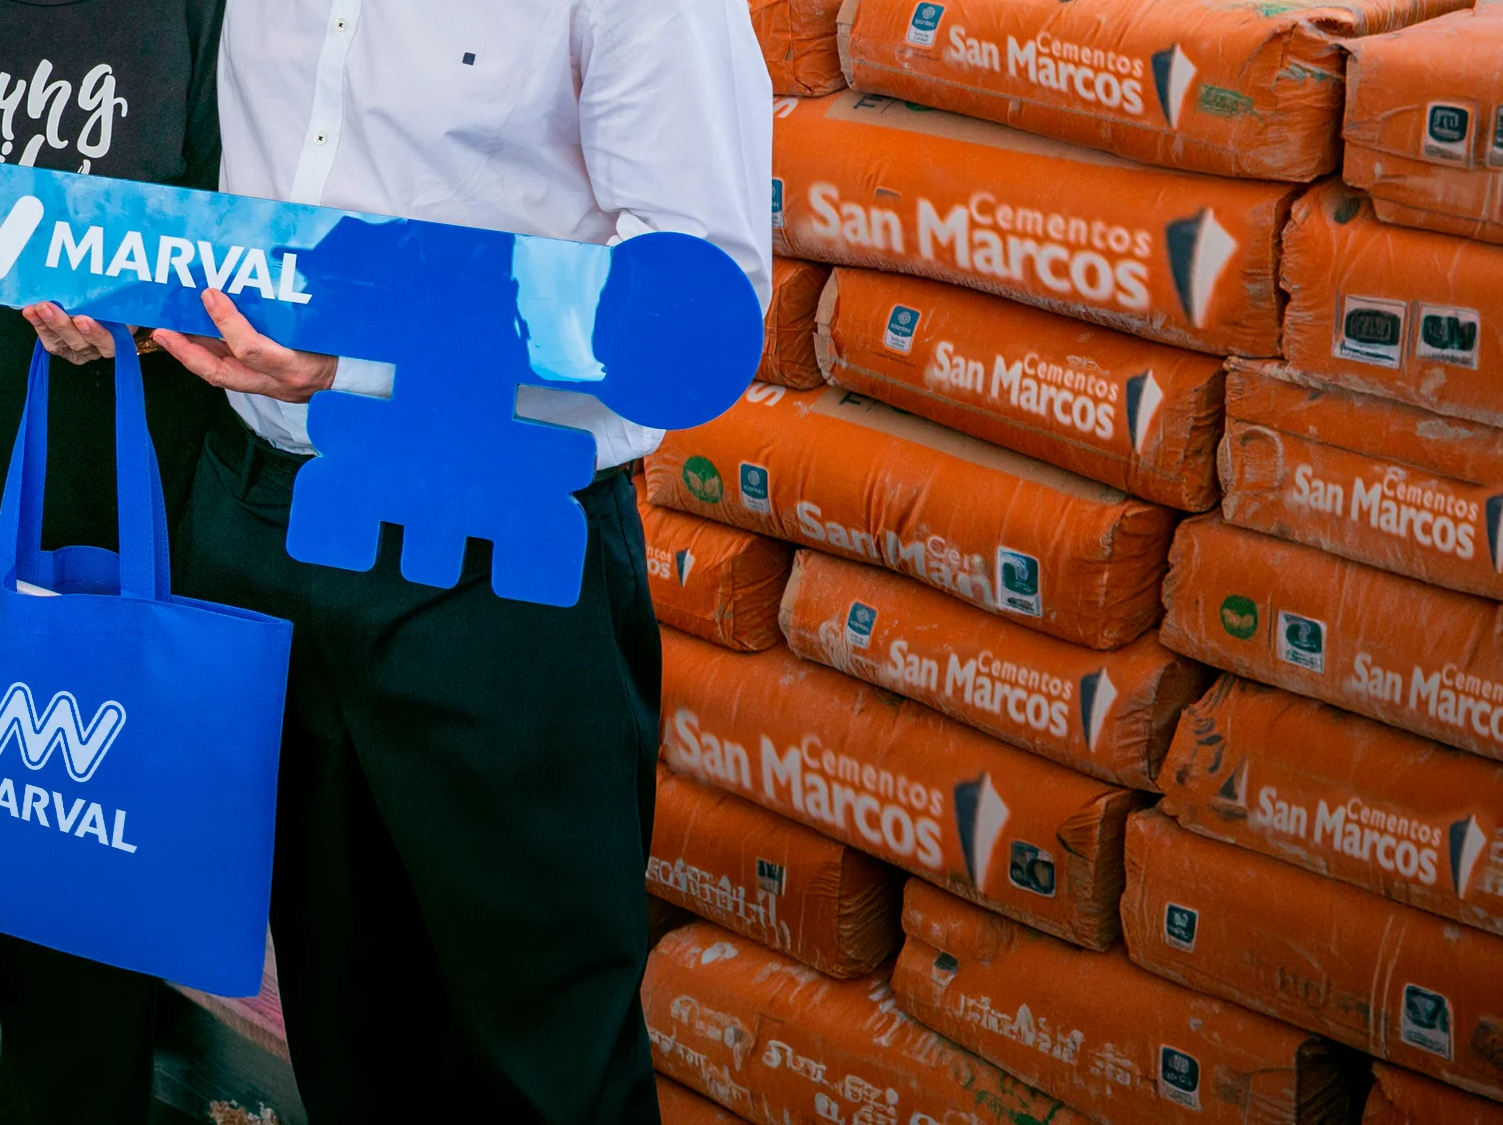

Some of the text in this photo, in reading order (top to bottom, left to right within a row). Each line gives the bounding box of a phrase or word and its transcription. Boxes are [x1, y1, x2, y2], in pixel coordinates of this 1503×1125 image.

[949, 25, 1000, 73] San
[1007, 35, 1145, 115] Marcos
[1037, 30, 1143, 76] Cementos
[45, 221, 313, 305] MARVAL
[808, 182, 1153, 310] San Marcos
[969, 191, 1153, 259] Cementos
[933, 340, 1116, 442] San Marcos
[1023, 352, 1119, 402] Cementos
[796, 500, 878, 559] San
[1293, 463, 1475, 560] San Marcos
[1384, 469, 1479, 522] Cementos
[887, 639, 1069, 737] San Marcos
[978, 650, 1073, 700] Cementos
[1351, 652, 1503, 743] San Marco
[1442, 662, 1503, 703] Cemen
[674, 707, 943, 869] San Marcos
[801, 732, 944, 817] Cementos
[1256, 786, 1307, 839] San
[1314, 799, 1438, 884] Marcos
[1347, 796, 1442, 848] Cementos
